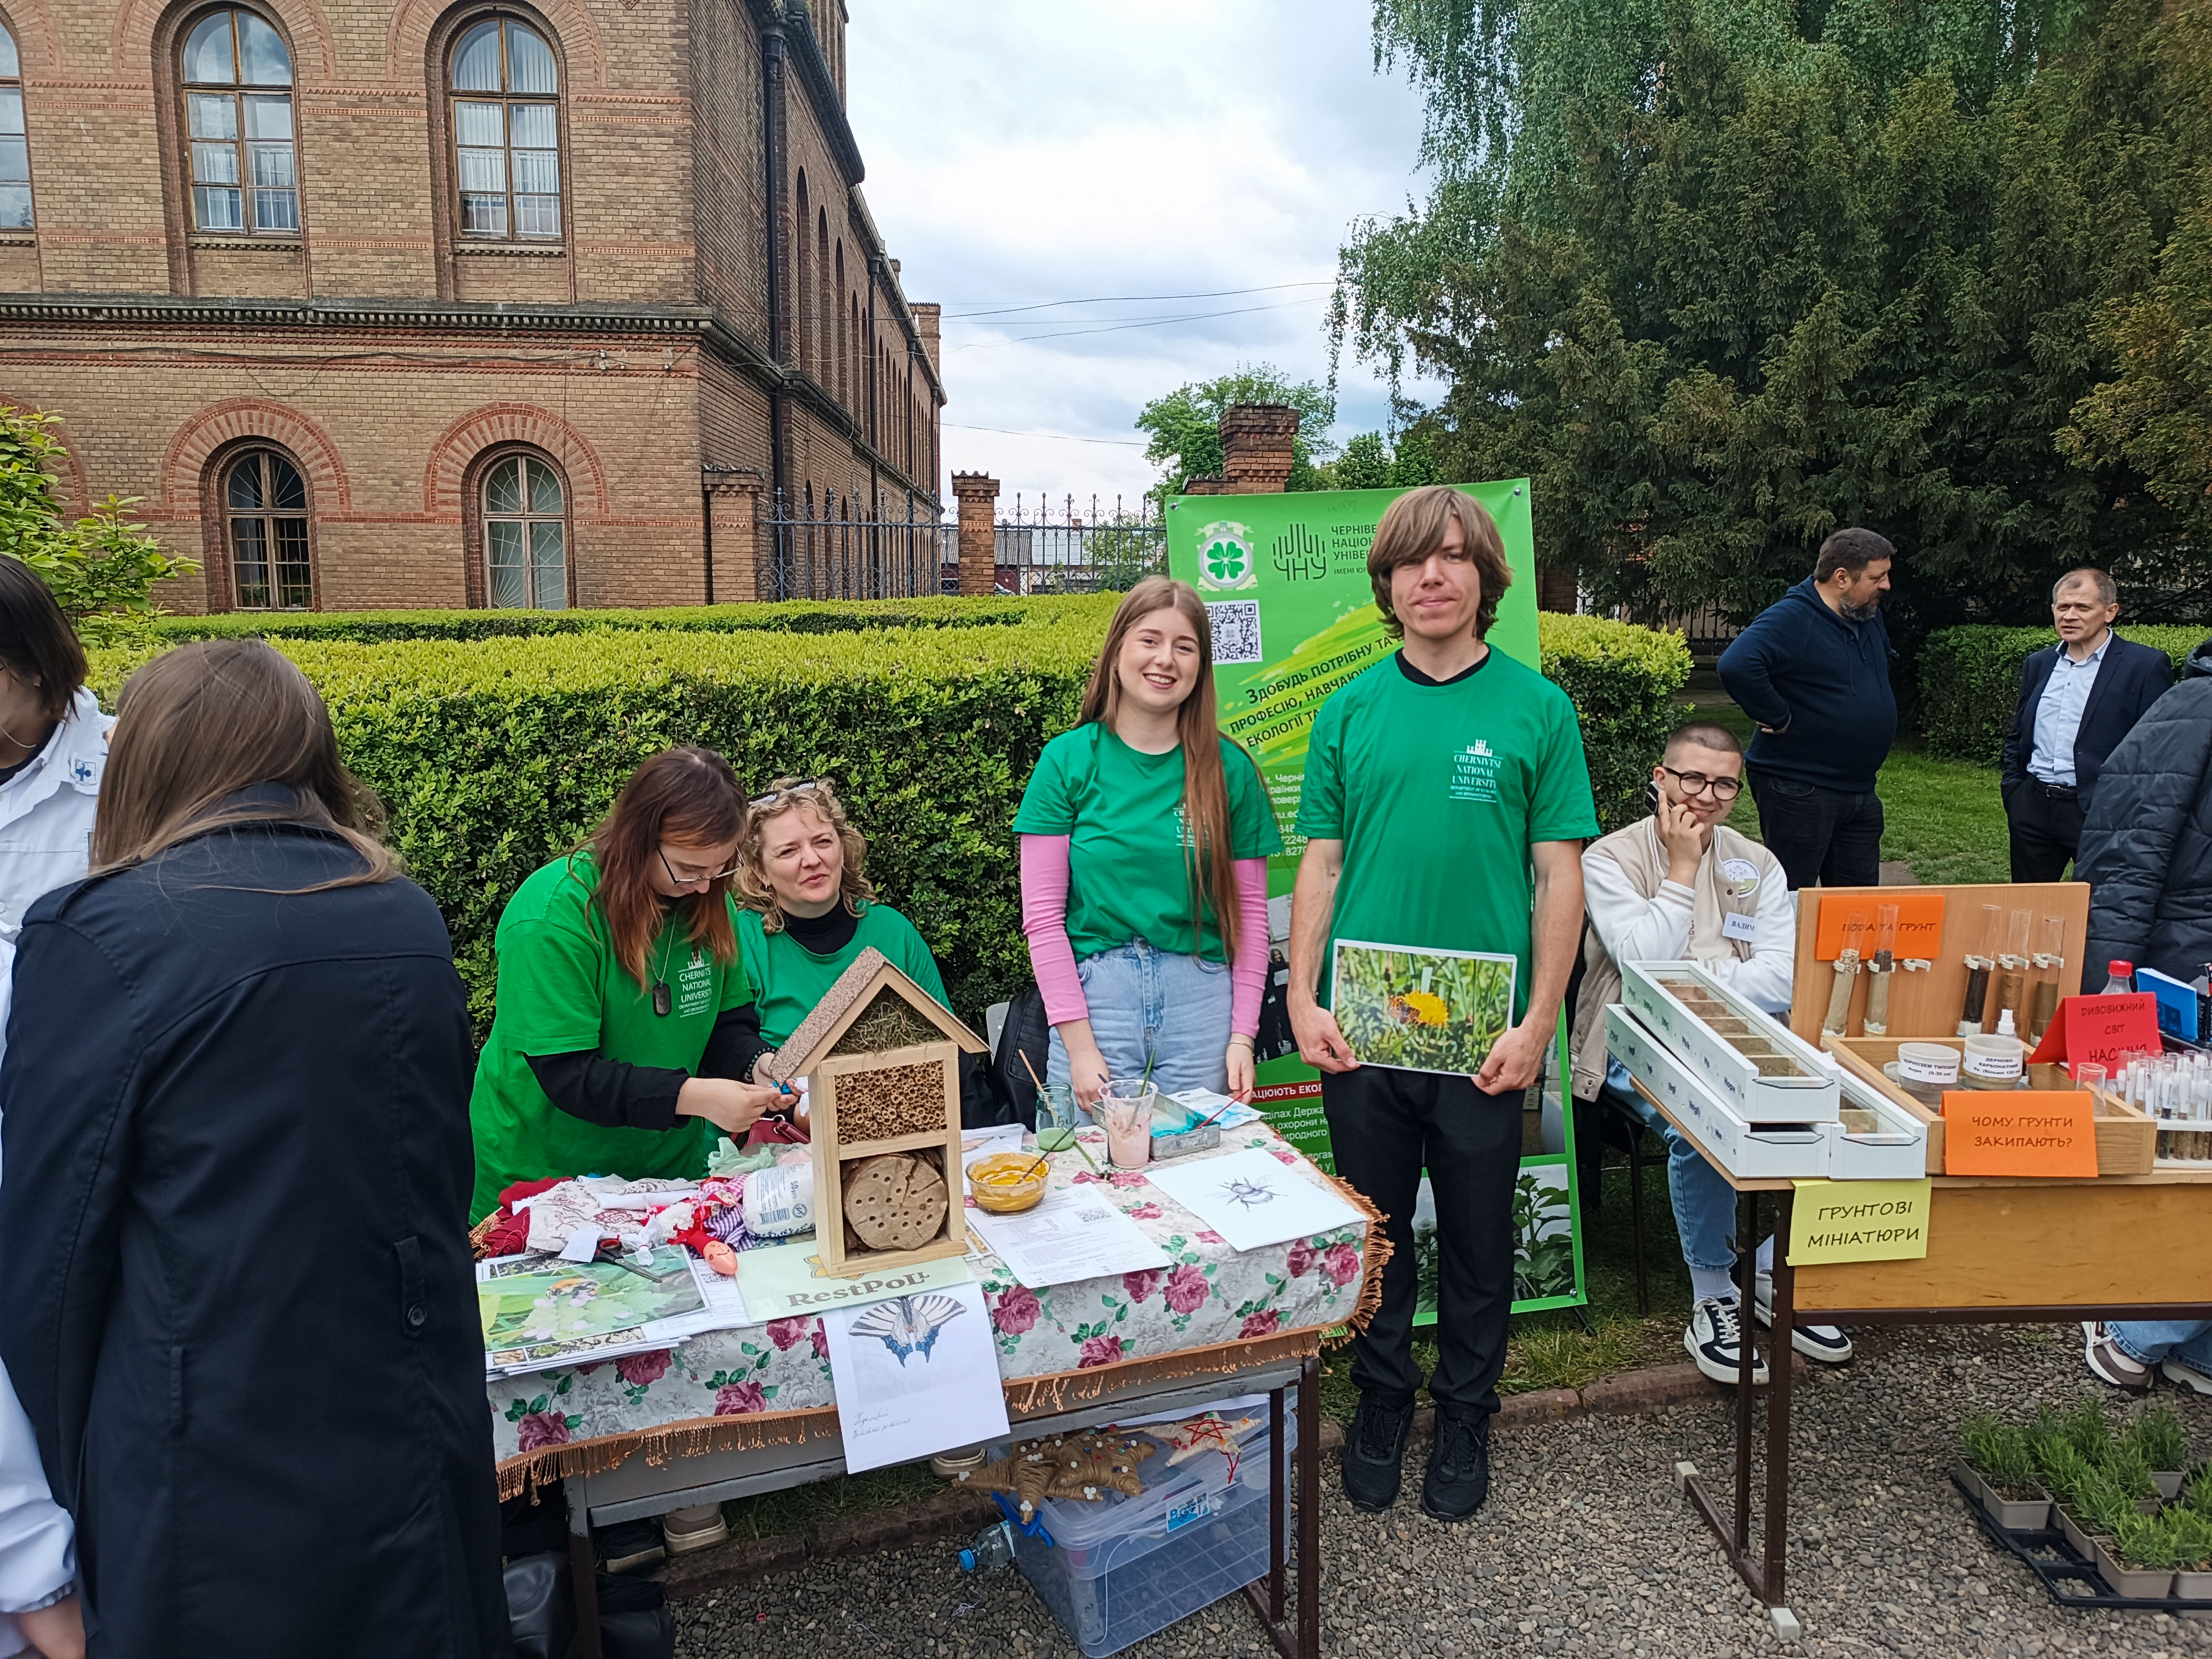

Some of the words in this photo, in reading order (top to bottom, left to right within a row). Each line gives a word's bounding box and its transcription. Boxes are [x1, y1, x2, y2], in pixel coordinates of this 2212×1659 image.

[1331, 524, 1377, 535] ЧЕРНІВЕ
[1332, 536, 1374, 549] НАЦІОН
[1333, 549, 1370, 561] УНІВЕ
[1311, 643, 1373, 678] ПОТРІБНУ
[1375, 636, 1393, 649] ТА
[1229, 697, 1303, 733] ПРОФЕСІЮ,
[1246, 715, 1303, 748] ЕКОЛОГІЇ
[1455, 764, 1495, 778] NATIONAL
[1731, 920, 1755, 931] ВАДИМ
[1898, 922, 1936, 932] ГРУНТ
[682, 978, 711, 992] NATIONAL
[2081, 999, 2146, 1016] ДИВОВИЖНИЙ
[2105, 1024, 2125, 1035] СВІТ
[1251, 1087, 1296, 1099] АЦЮЮТЬ
[1298, 1083, 1322, 1094] ЕКОЛ
[1262, 1109, 1291, 1120] ділах
[1293, 1106, 1324, 1118] Держа
[1277, 1118, 1317, 1130] охорони
[1972, 1116, 2014, 1127] ЧОМУ
[2018, 1117, 2073, 1128] ГРУНТИ
[1281, 1129, 1327, 1142] иродного
[1974, 1136, 2073, 1148] ЗАКИПАЮТЬ?
[1818, 1201, 1913, 1221] ГРУНТОВІ
[1807, 1227, 1919, 1248] МІНІАТЮРИ
